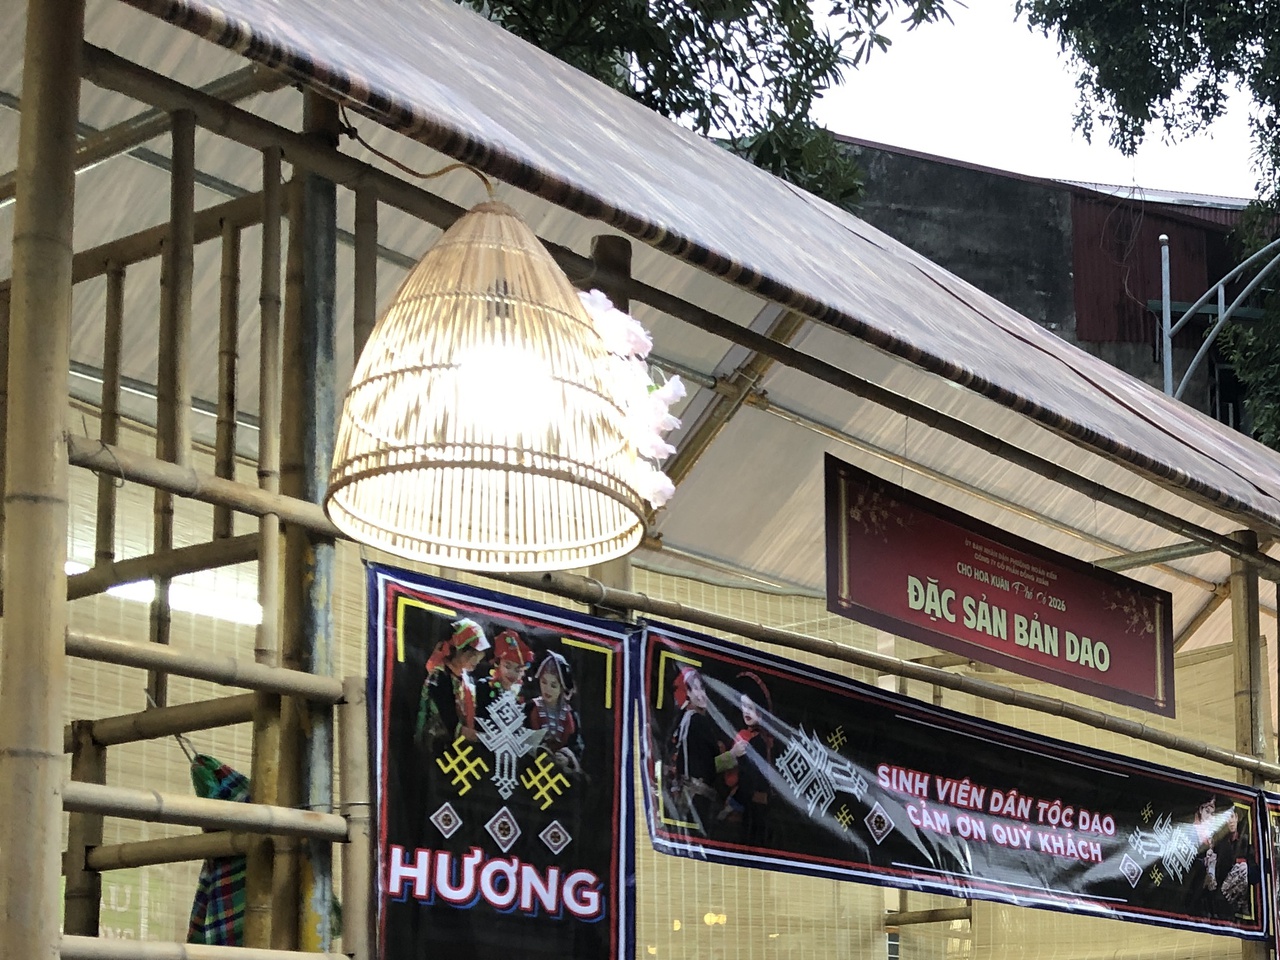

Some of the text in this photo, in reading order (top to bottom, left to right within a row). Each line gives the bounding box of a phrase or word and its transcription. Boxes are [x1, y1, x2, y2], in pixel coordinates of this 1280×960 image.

[957, 562, 972, 578] CHỢ
[974, 568, 989, 584] HOA
[991, 574, 1010, 592] XUÂN
[1048, 596, 1066, 612] 2026
[907, 575, 1110, 672] ĐẶC SẢN BẢN DAO
[877, 764, 1115, 835] SINH VIÊN DÂN TỘC DAO
[906, 799, 1102, 862] CẢM ƠN QUÝ KHÁCH
[388, 844, 603, 920] HƯƠNG
